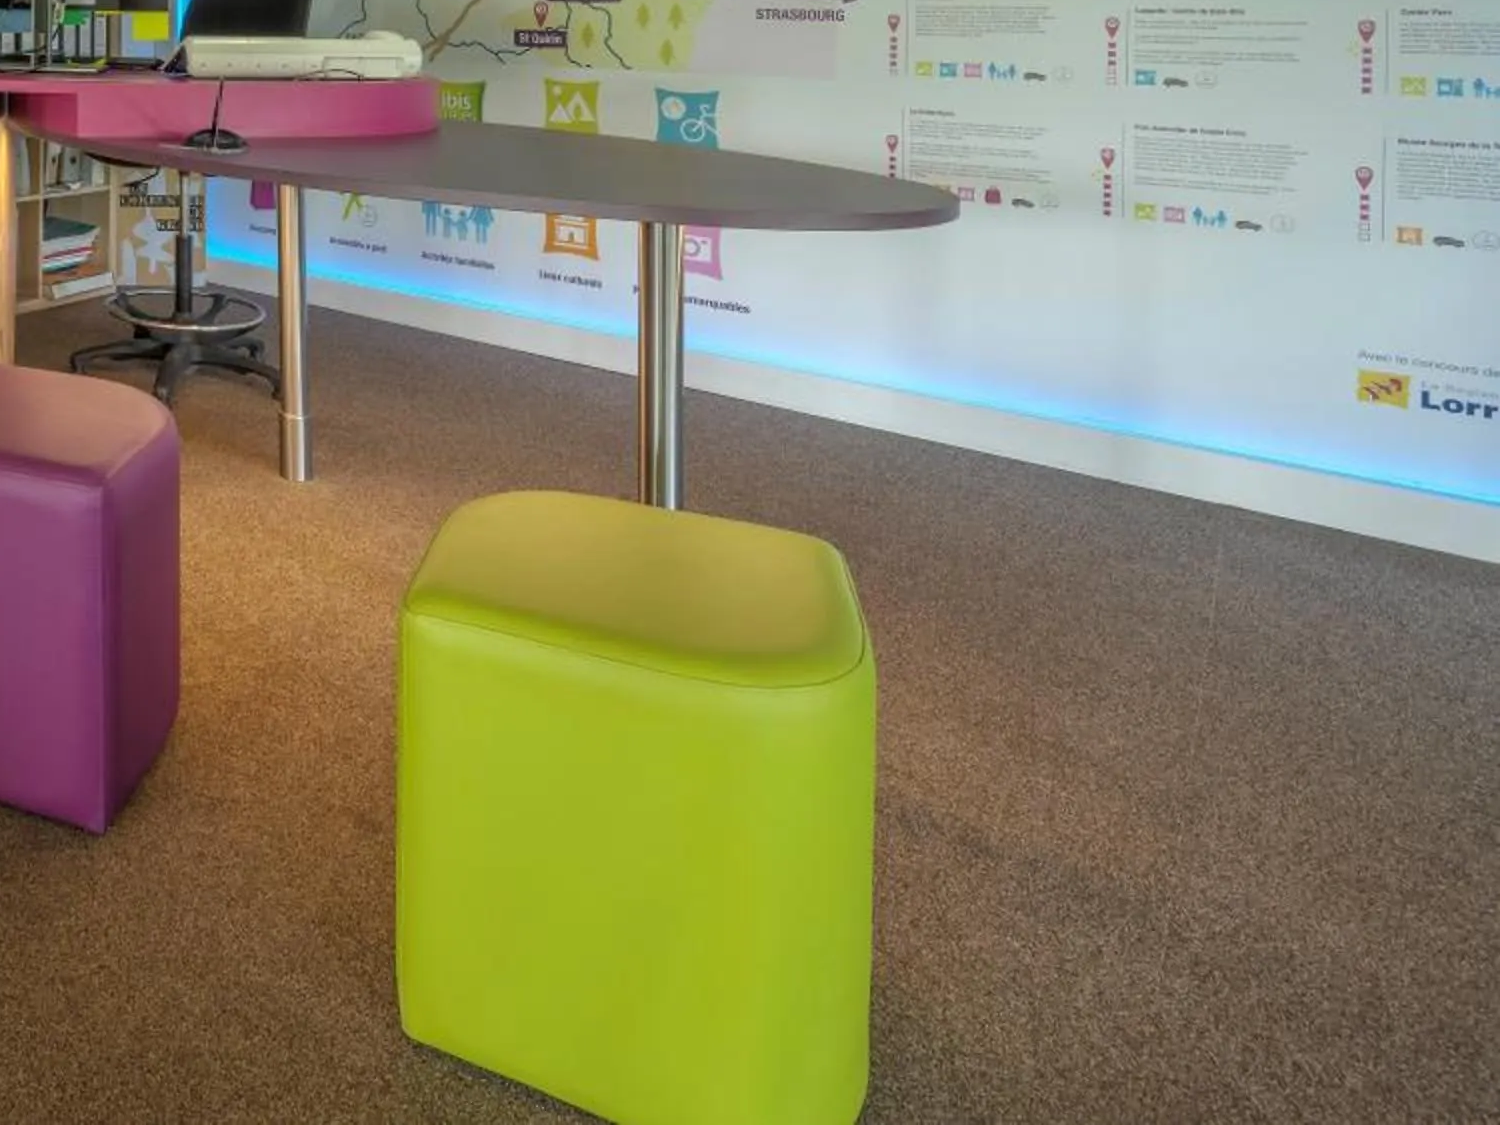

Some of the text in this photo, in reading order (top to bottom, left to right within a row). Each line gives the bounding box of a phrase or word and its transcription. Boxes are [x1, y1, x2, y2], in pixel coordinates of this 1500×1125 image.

[755, 7, 846, 22] STRASBOURG
[441, 90, 472, 110] ibis
[1411, 357, 1480, 376] concours
[1420, 390, 1499, 420] Lorr
